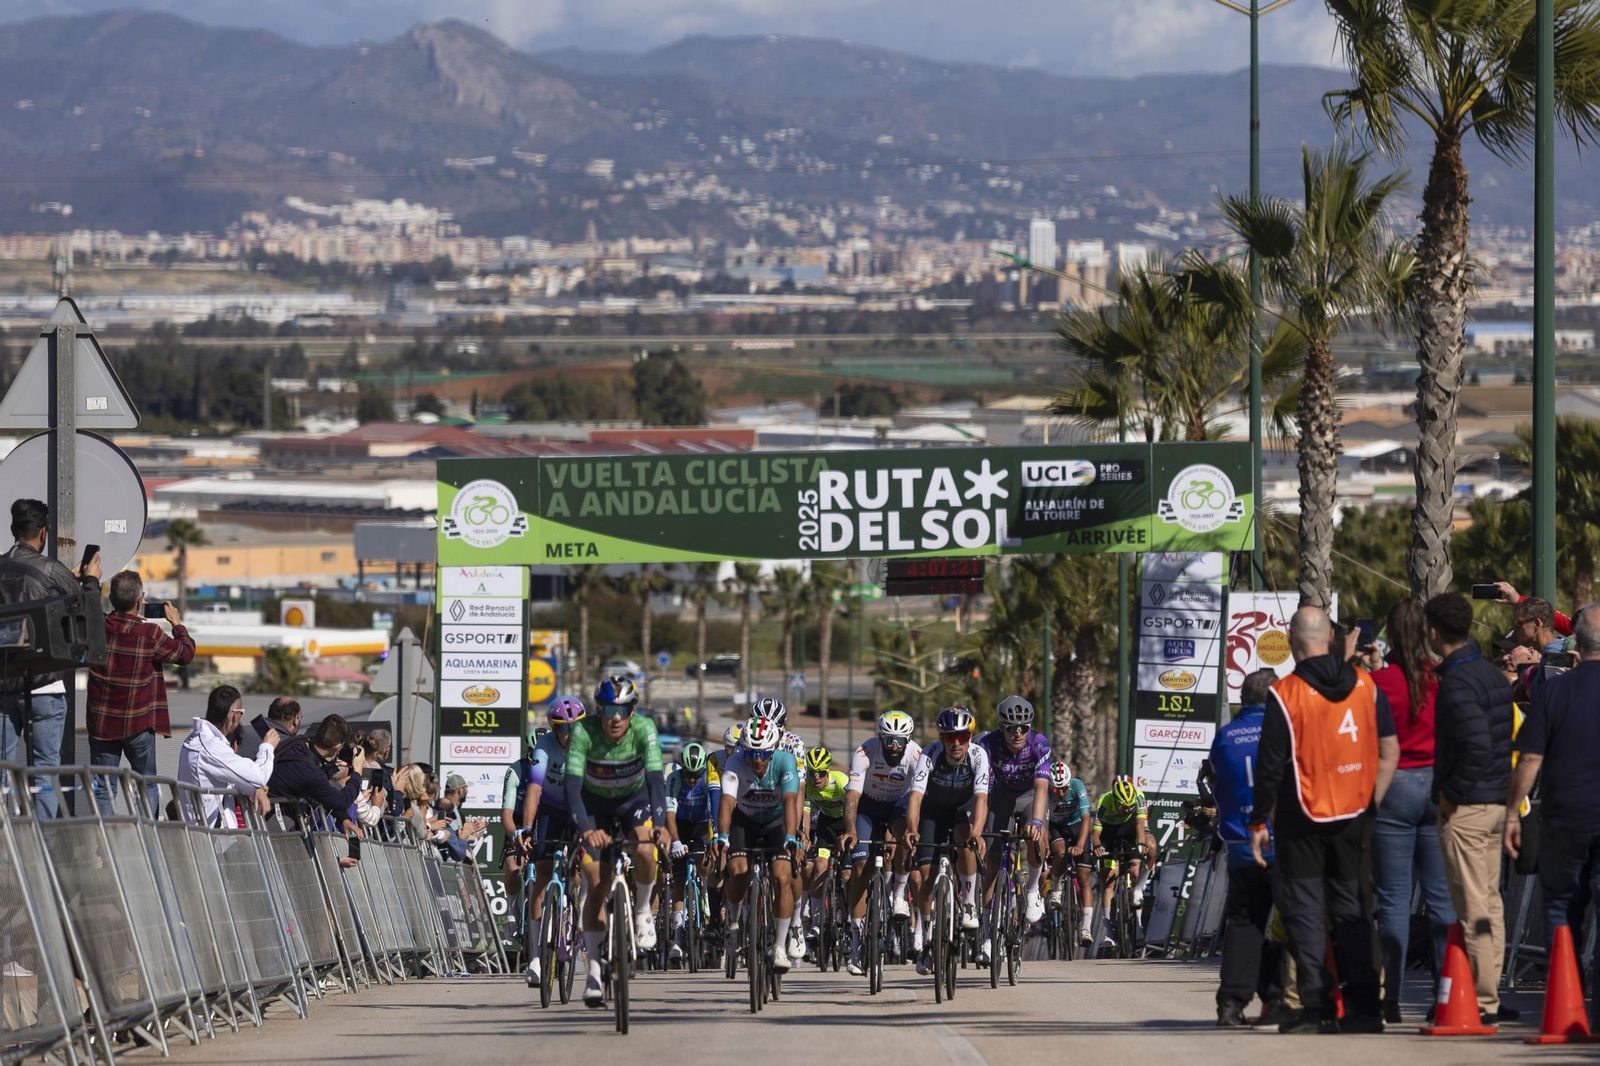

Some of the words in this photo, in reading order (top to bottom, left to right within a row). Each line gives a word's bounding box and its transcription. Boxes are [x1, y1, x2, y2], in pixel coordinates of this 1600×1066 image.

[545, 461, 675, 489] VUELTA
[686, 458, 831, 487] CICLISTA
[1027, 466, 1066, 482] UCI
[1100, 463, 1120, 472] PRO
[1100, 471, 1132, 481] SERIES
[819, 467, 951, 511] RUTA
[546, 491, 571, 517] A
[580, 483, 782, 516] ANDALUCÍA
[1025, 498, 1086, 510] ALHAURÍN
[1089, 499, 1104, 509] DE
[798, 489, 819, 551] 2025
[1025, 511, 1039, 521] LA
[1042, 511, 1080, 521] TORRE
[820, 510, 914, 552] DEL
[921, 509, 1022, 549] SOL
[1067, 526, 1146, 545] ARRIVÈE
[546, 543, 599, 558] META
[1143, 617, 1203, 630] GSPORT
[444, 633, 505, 644] GSPORT
[445, 659, 518, 668] AQUAMARINA
[1338, 708, 1358, 743] 4
[1149, 729, 1201, 740] GARCIDEN
[454, 745, 507, 755] GARCIDEN
[1147, 798, 1183, 812] porinter
[1157, 819, 1184, 848] 71
